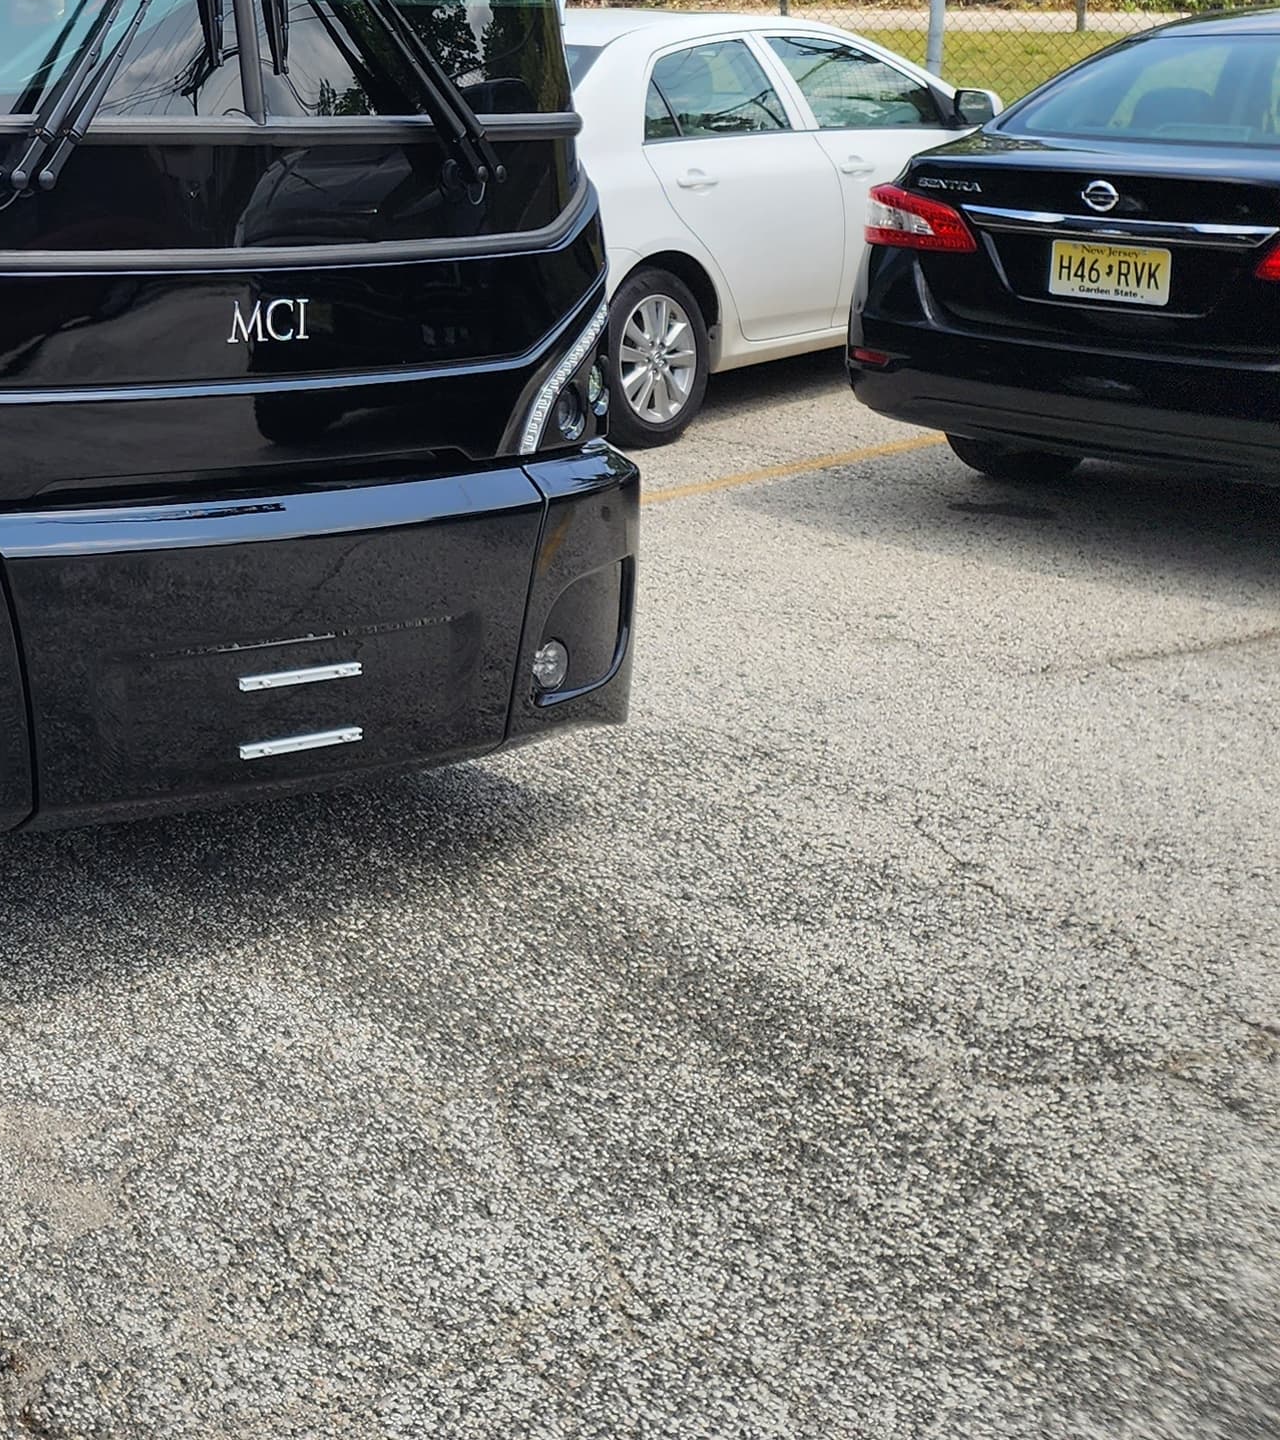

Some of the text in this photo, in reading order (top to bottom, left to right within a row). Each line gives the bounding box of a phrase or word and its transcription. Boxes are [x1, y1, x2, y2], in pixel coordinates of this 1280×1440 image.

[918, 177, 982, 193] SENTRA
[1081, 244, 1139, 258] New Jersey
[1058, 255, 1161, 290] H46 RVK
[1078, 285, 1138, 298] Garden State
[227, 298, 310, 343] MCI
